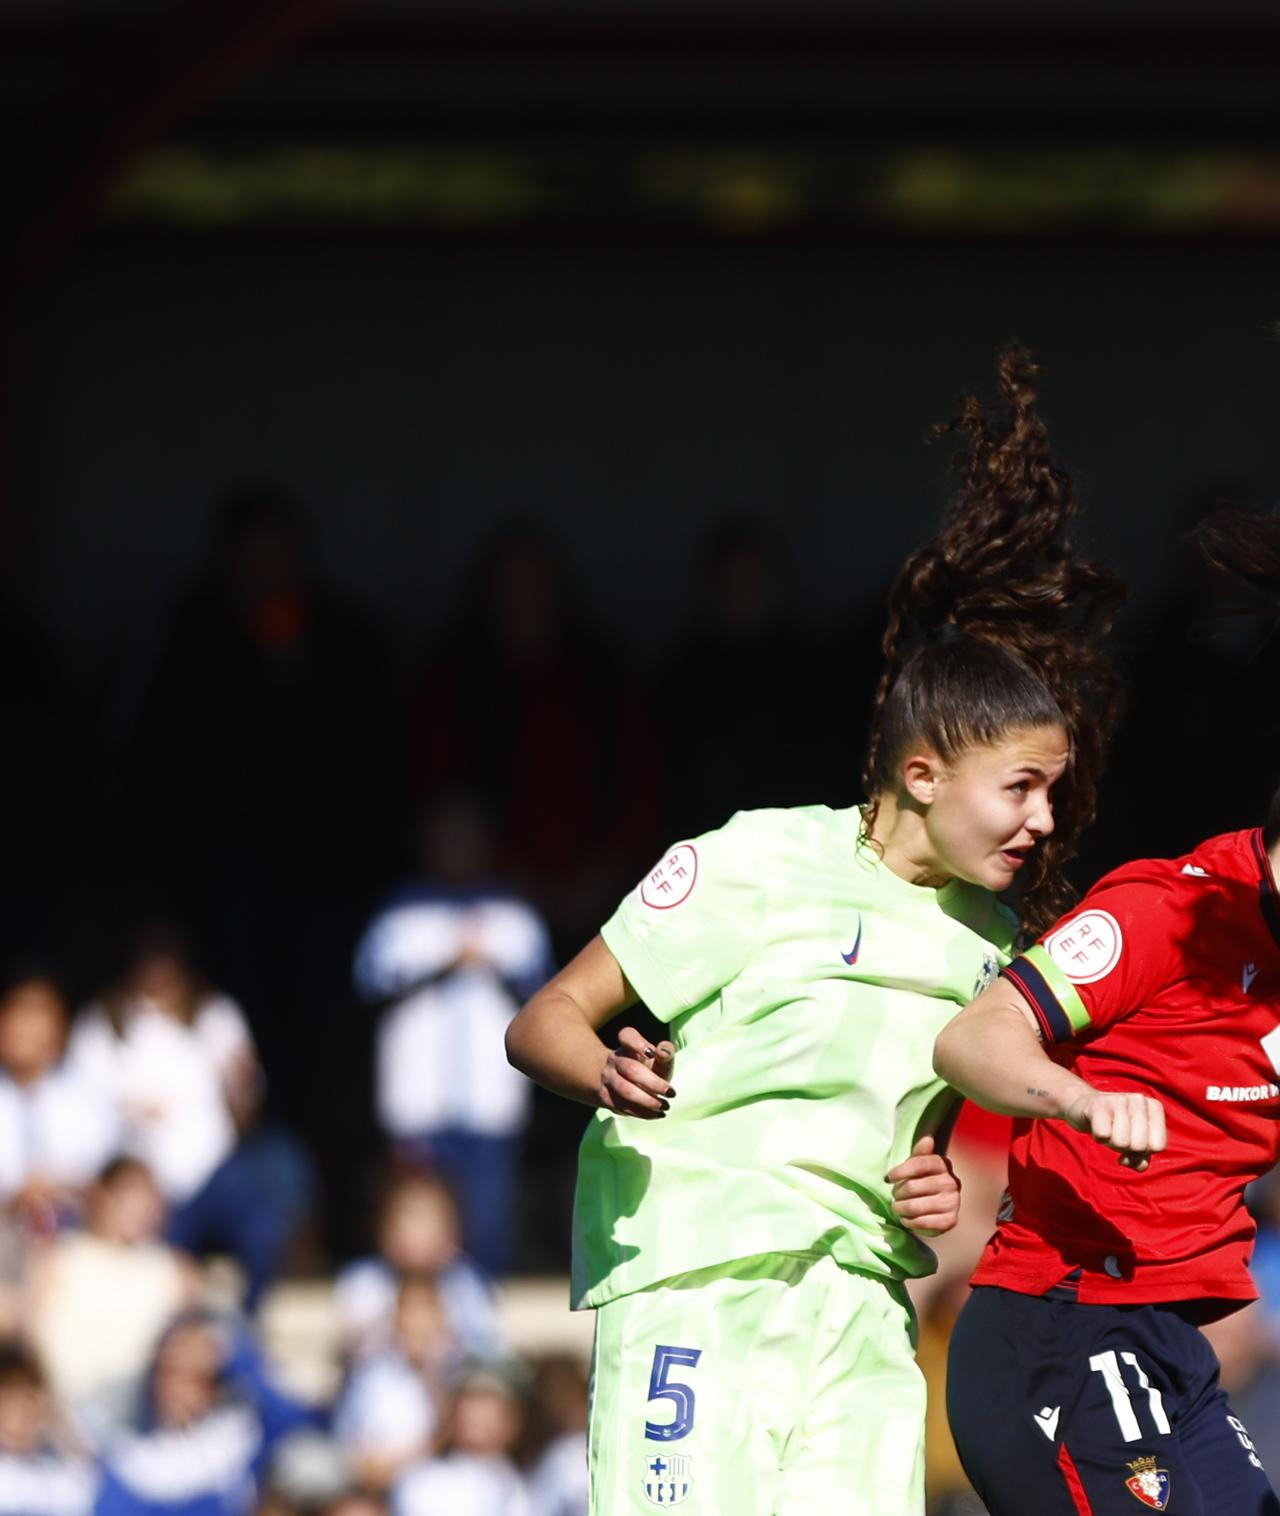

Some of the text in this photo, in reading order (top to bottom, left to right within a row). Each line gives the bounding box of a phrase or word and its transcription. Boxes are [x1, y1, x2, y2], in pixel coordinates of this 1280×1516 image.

[1205, 1085, 1269, 1102] BAIKOR
[645, 1344, 703, 1442] 5
[1088, 1350, 1172, 1443] 11
